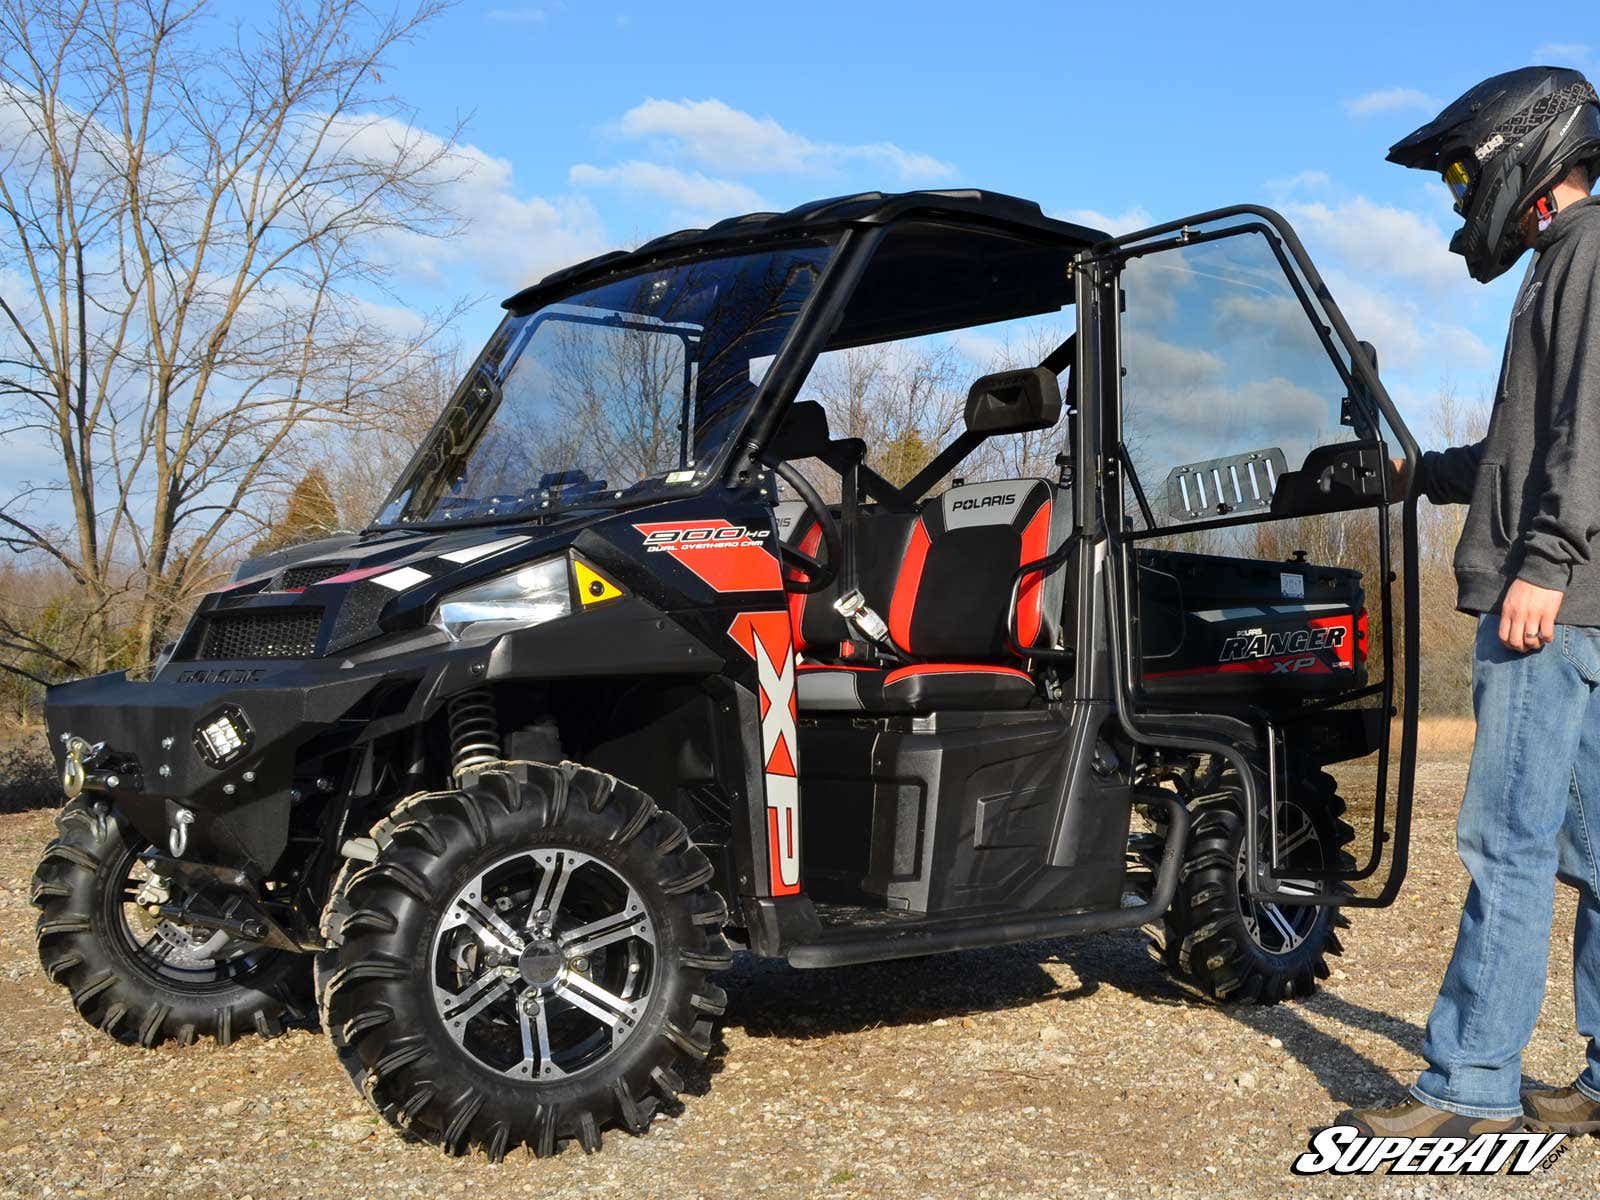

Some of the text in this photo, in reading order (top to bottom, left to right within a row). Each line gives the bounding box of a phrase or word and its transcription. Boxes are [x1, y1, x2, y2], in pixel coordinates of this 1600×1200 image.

[952, 494, 1016, 512] POLARIS
[643, 526, 771, 545] 900 HO
[647, 544, 678, 552] DUAL
[681, 541, 738, 550] OVERHEAD
[1219, 626, 1347, 661] RANGER
[1271, 656, 1316, 674] XP
